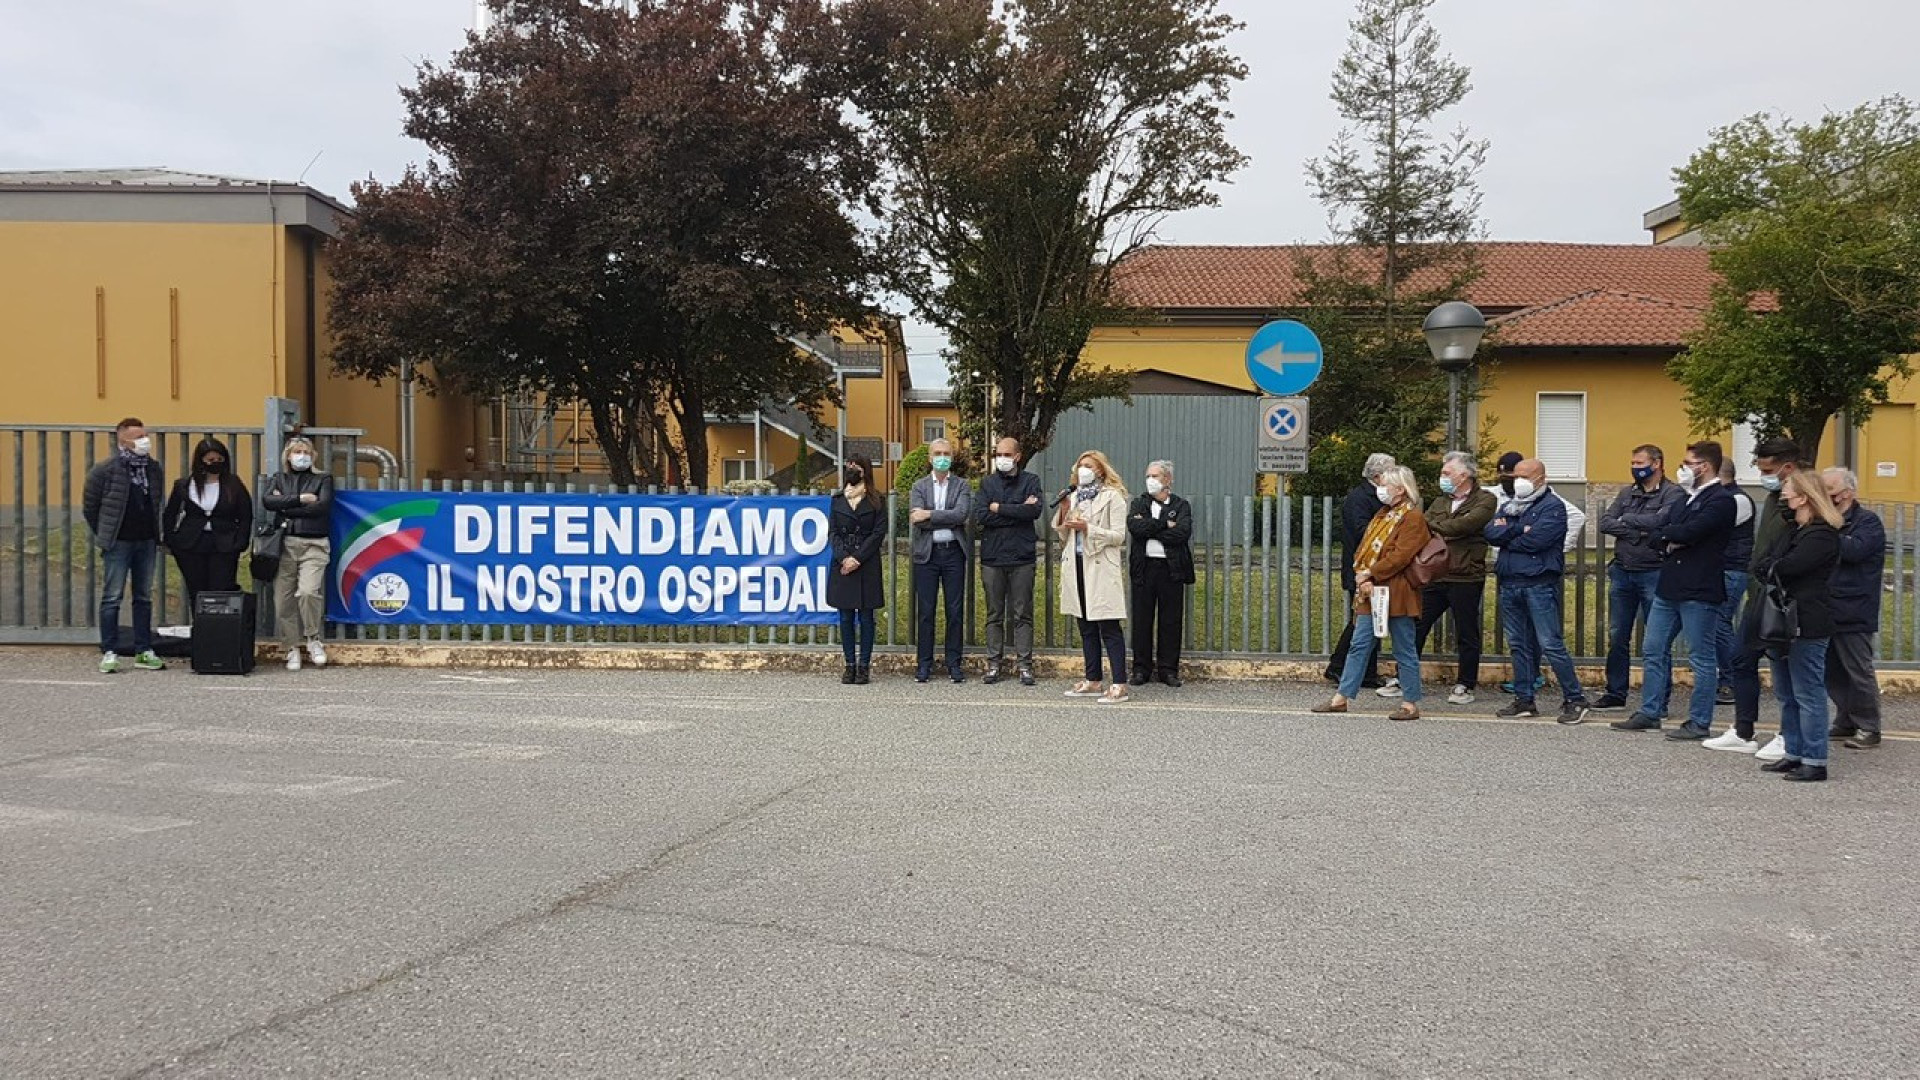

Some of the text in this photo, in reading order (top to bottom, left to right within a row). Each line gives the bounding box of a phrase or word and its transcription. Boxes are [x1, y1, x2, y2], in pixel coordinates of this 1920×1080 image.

[454, 504, 829, 555] DIFENDIAMO
[369, 575, 403, 589] LEGA
[427, 563, 838, 613] IL NOSTRO OSPEDAL
